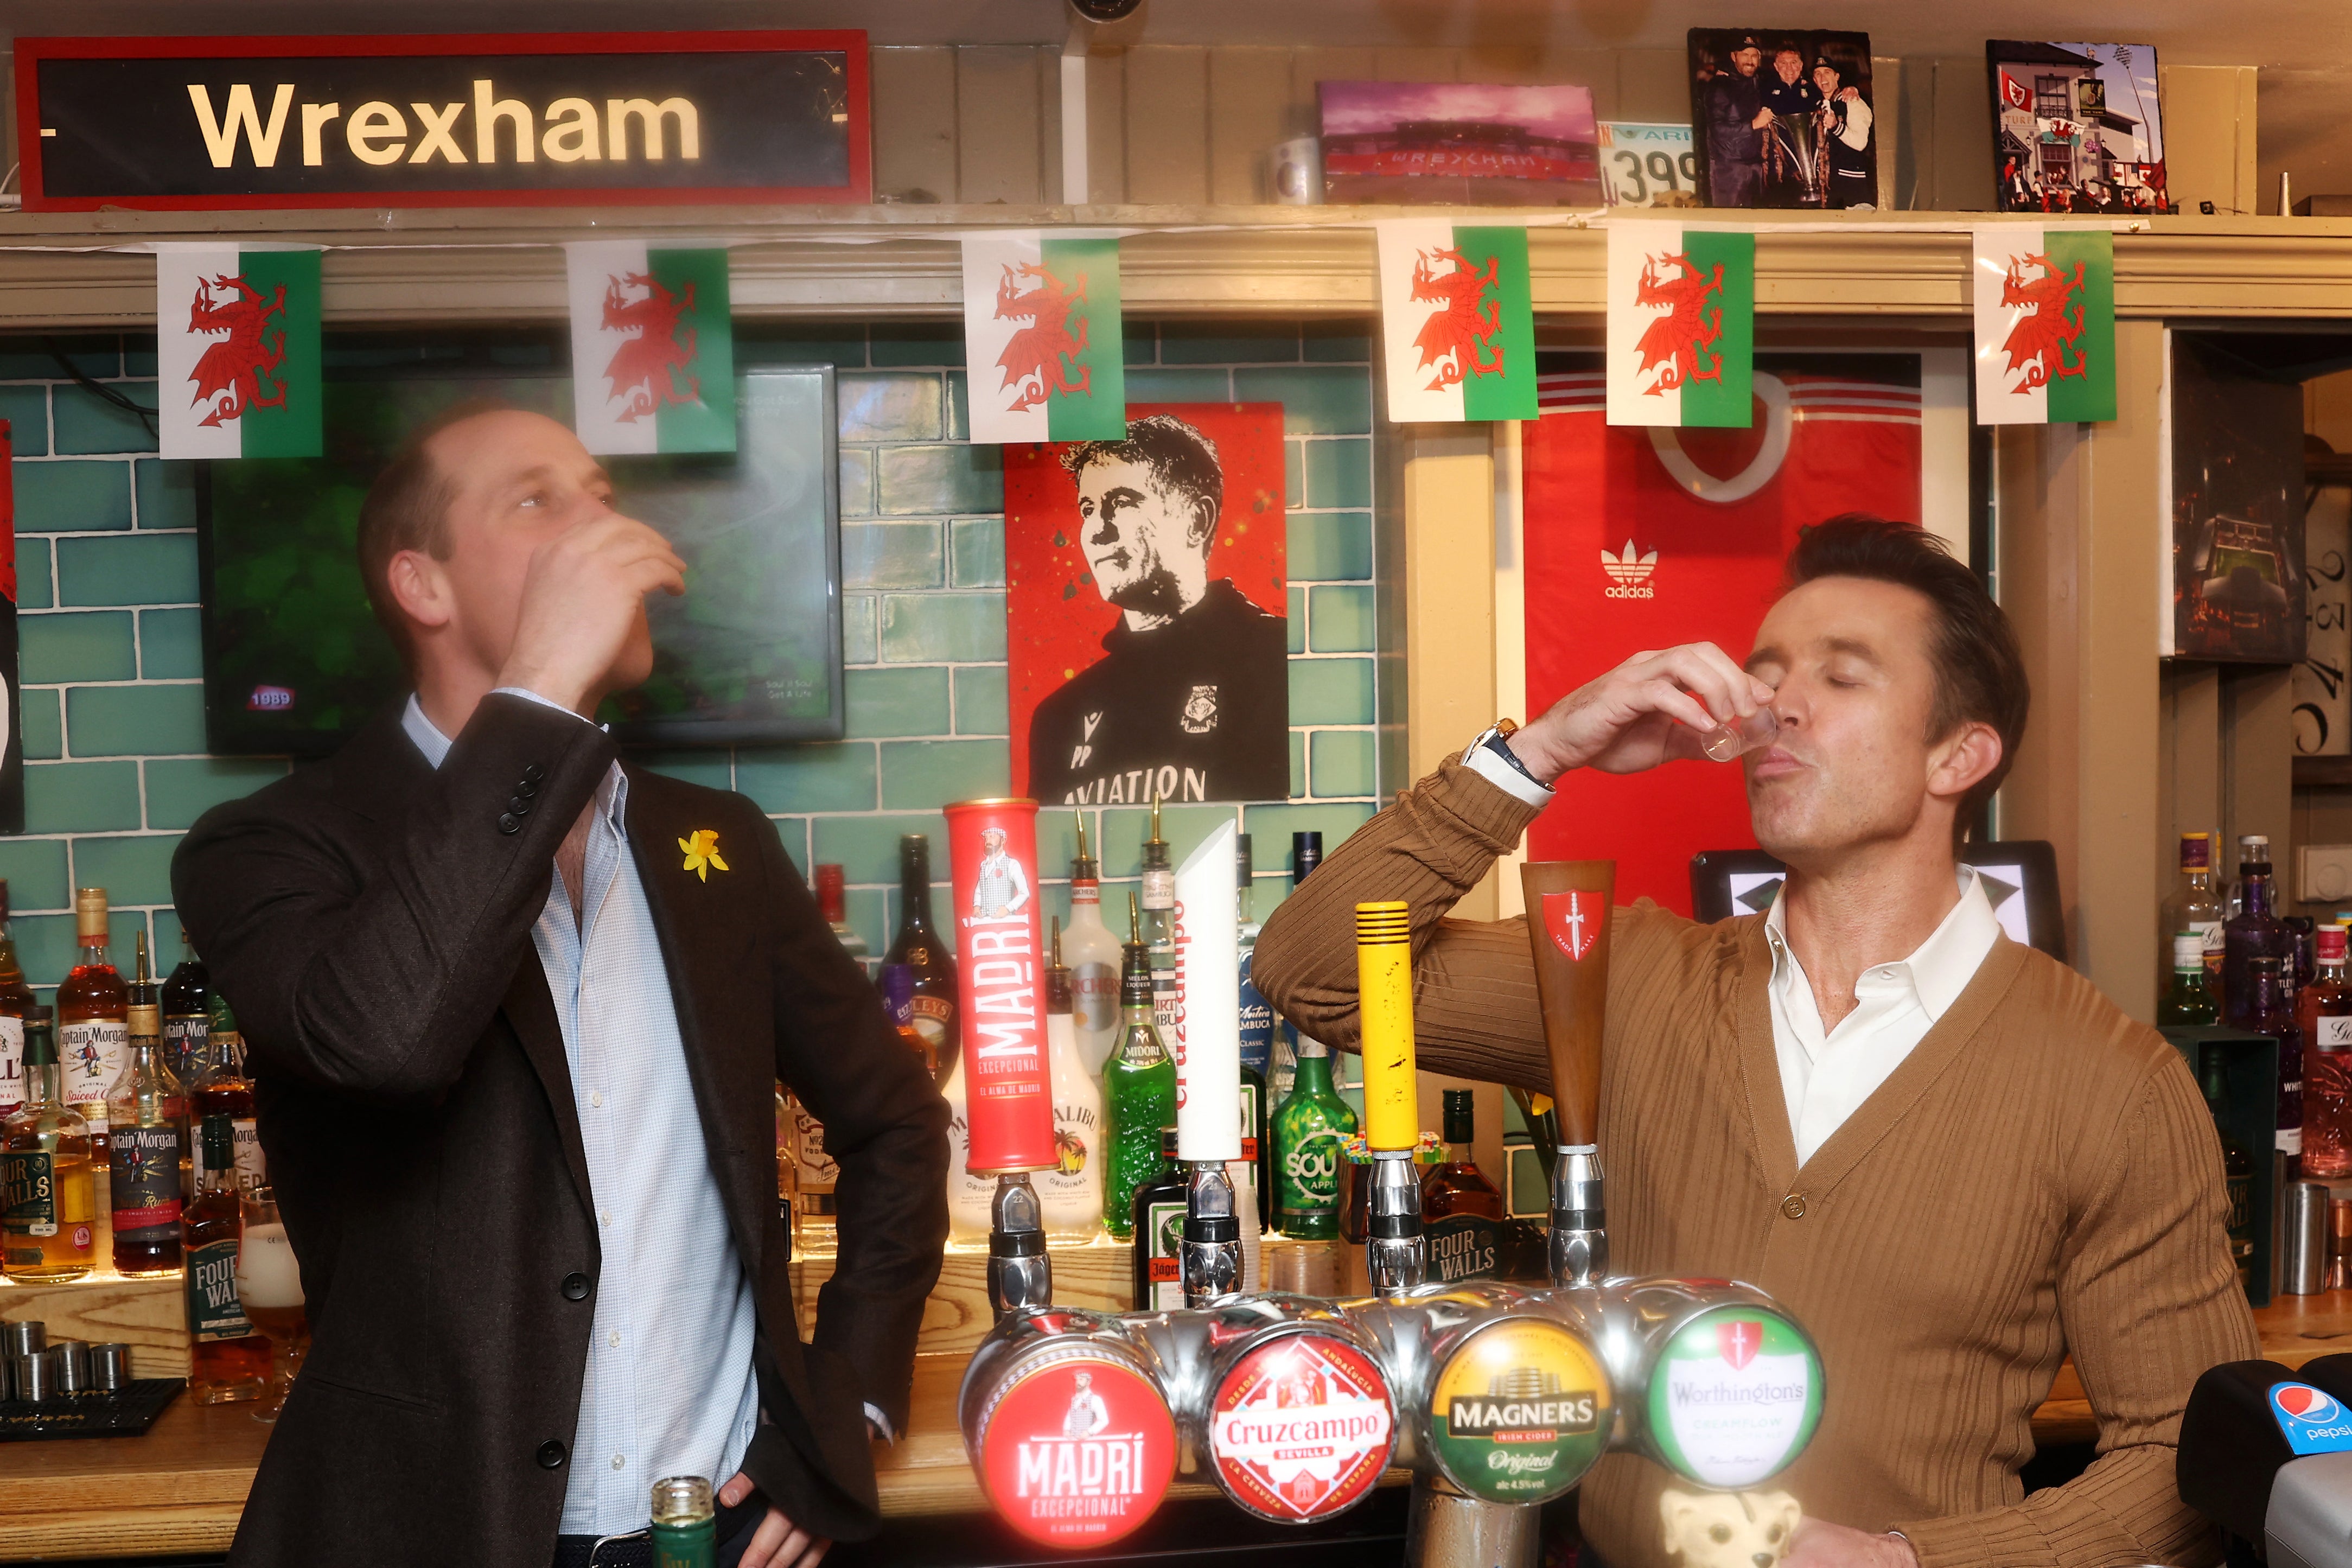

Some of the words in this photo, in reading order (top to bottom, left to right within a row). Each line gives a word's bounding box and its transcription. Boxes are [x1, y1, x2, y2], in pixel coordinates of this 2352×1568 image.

[187, 78, 701, 170] Wrexham
[2005, 115, 2032, 124] TURF
[1604, 584, 1654, 599] adidas
[252, 693, 290, 705] 1989
[1556, 934, 1573, 952] TRADE
[1580, 934, 1594, 952] MARK
[1125, 1046, 1161, 1059] MIDORI
[978, 1059, 1040, 1074] EXCEPCIONAL
[66, 1089, 98, 1102] Spiced
[980, 1087, 987, 1096] EL
[989, 1086, 1006, 1095] ALMA
[1009, 1085, 1017, 1094] DE
[134, 1131, 177, 1150] Morgan
[1049, 1177, 1088, 1188] ORIGINAL
[1013, 1195, 1024, 1204] 22
[1431, 1229, 1476, 1262] FOUR
[1439, 1247, 1495, 1281] WALLS
[1227, 1374, 1256, 1405] DESDE
[1673, 1380, 1805, 1407] Worthington's
[1454, 1398, 1593, 1428] MAGNERS
[1227, 1414, 1378, 1445] Cruzcampo
[1692, 1417, 1783, 1430] CREAMFLOW
[1497, 1433, 1523, 1442] IRISH
[1526, 1432, 1552, 1440] CIDER
[2306, 1425, 2352, 1441] pepsi
[1278, 1447, 1329, 1459] SEVILLA
[1487, 1449, 1559, 1476] Original
[1228, 1461, 1240, 1475] LA
[1242, 1474, 1282, 1509] CERVEZA
